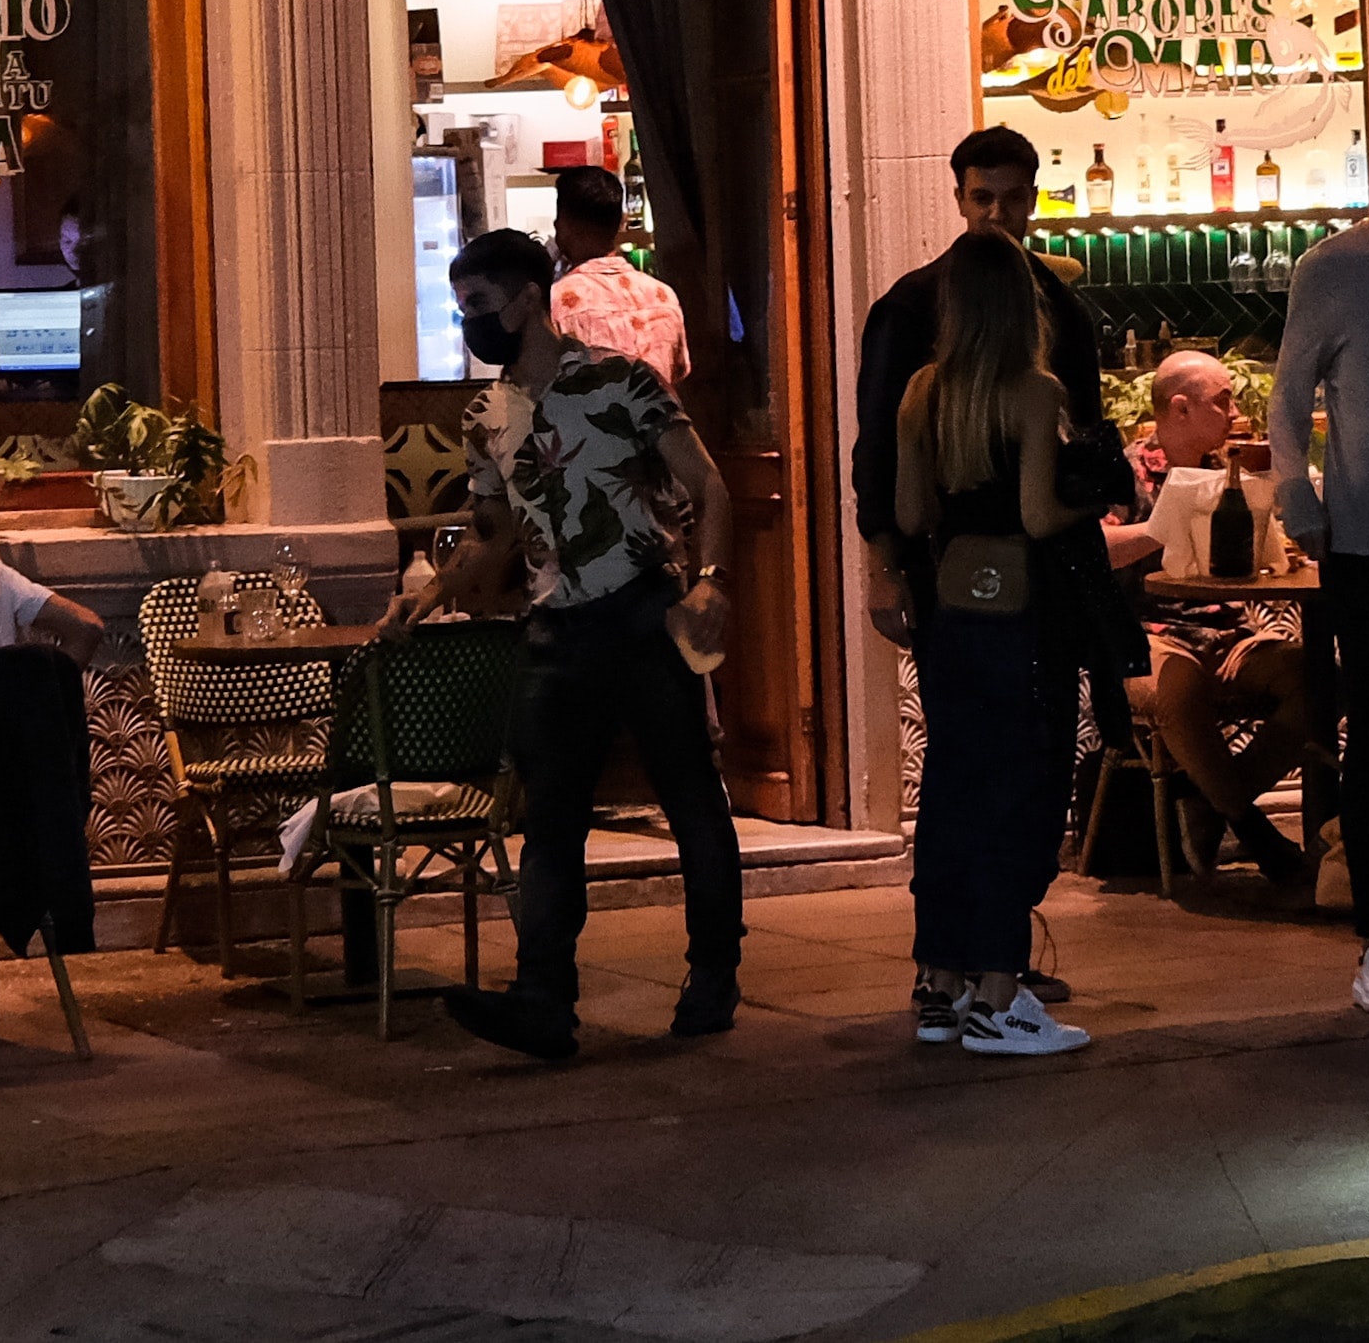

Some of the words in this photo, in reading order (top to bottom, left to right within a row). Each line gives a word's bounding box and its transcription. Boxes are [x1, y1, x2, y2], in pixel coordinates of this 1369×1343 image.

[2, 50, 31, 81] A
[1046, 45, 1093, 96] del
[3, 80, 54, 110] TU
